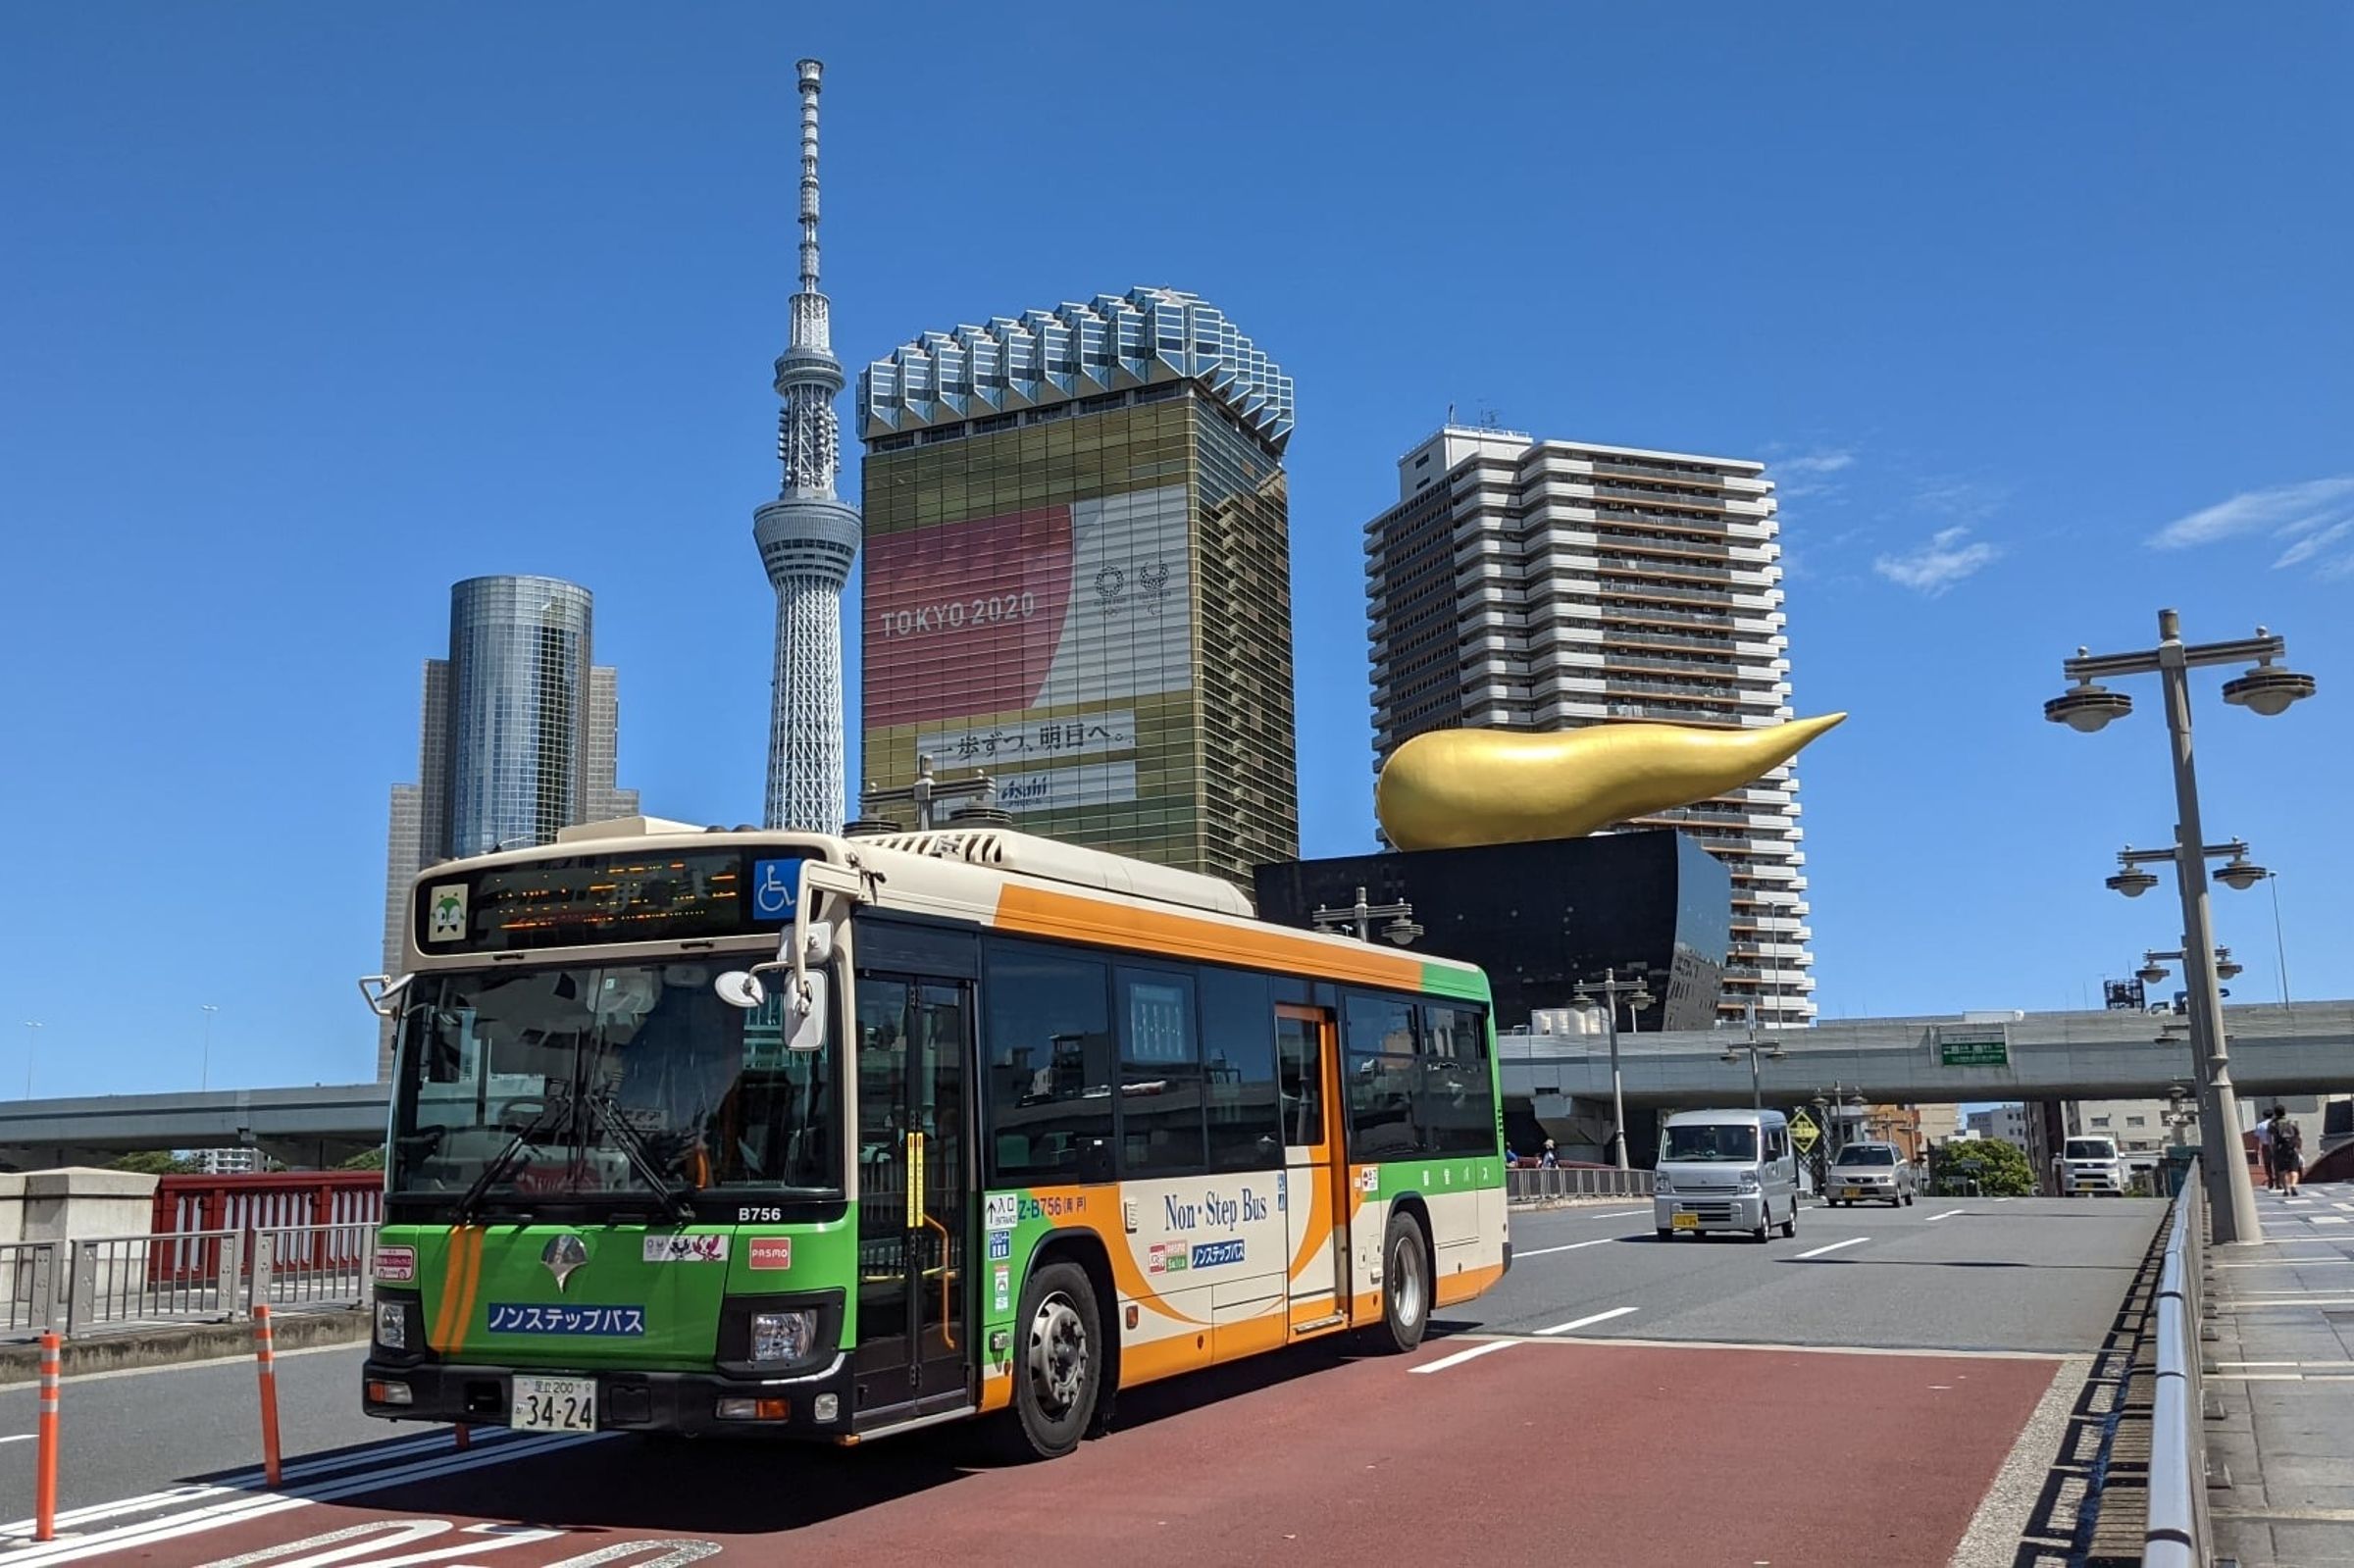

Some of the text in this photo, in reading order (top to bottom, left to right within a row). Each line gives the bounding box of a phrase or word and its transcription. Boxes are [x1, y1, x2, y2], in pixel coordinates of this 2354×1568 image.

[881, 591, 1035, 637] TOKYO 2020
[933, 723, 1124, 762] 一歩ずつ、明日へ。
[1001, 776, 1047, 799] Asahi
[739, 1207, 782, 1221] B756
[1205, 1190, 1237, 1232] Step
[1241, 1188, 1267, 1222] Bus
[751, 1248, 788, 1258] PASMO
[1193, 1242, 1245, 1267] ノンステップバス
[489, 1307, 643, 1332] ノンステップバス
